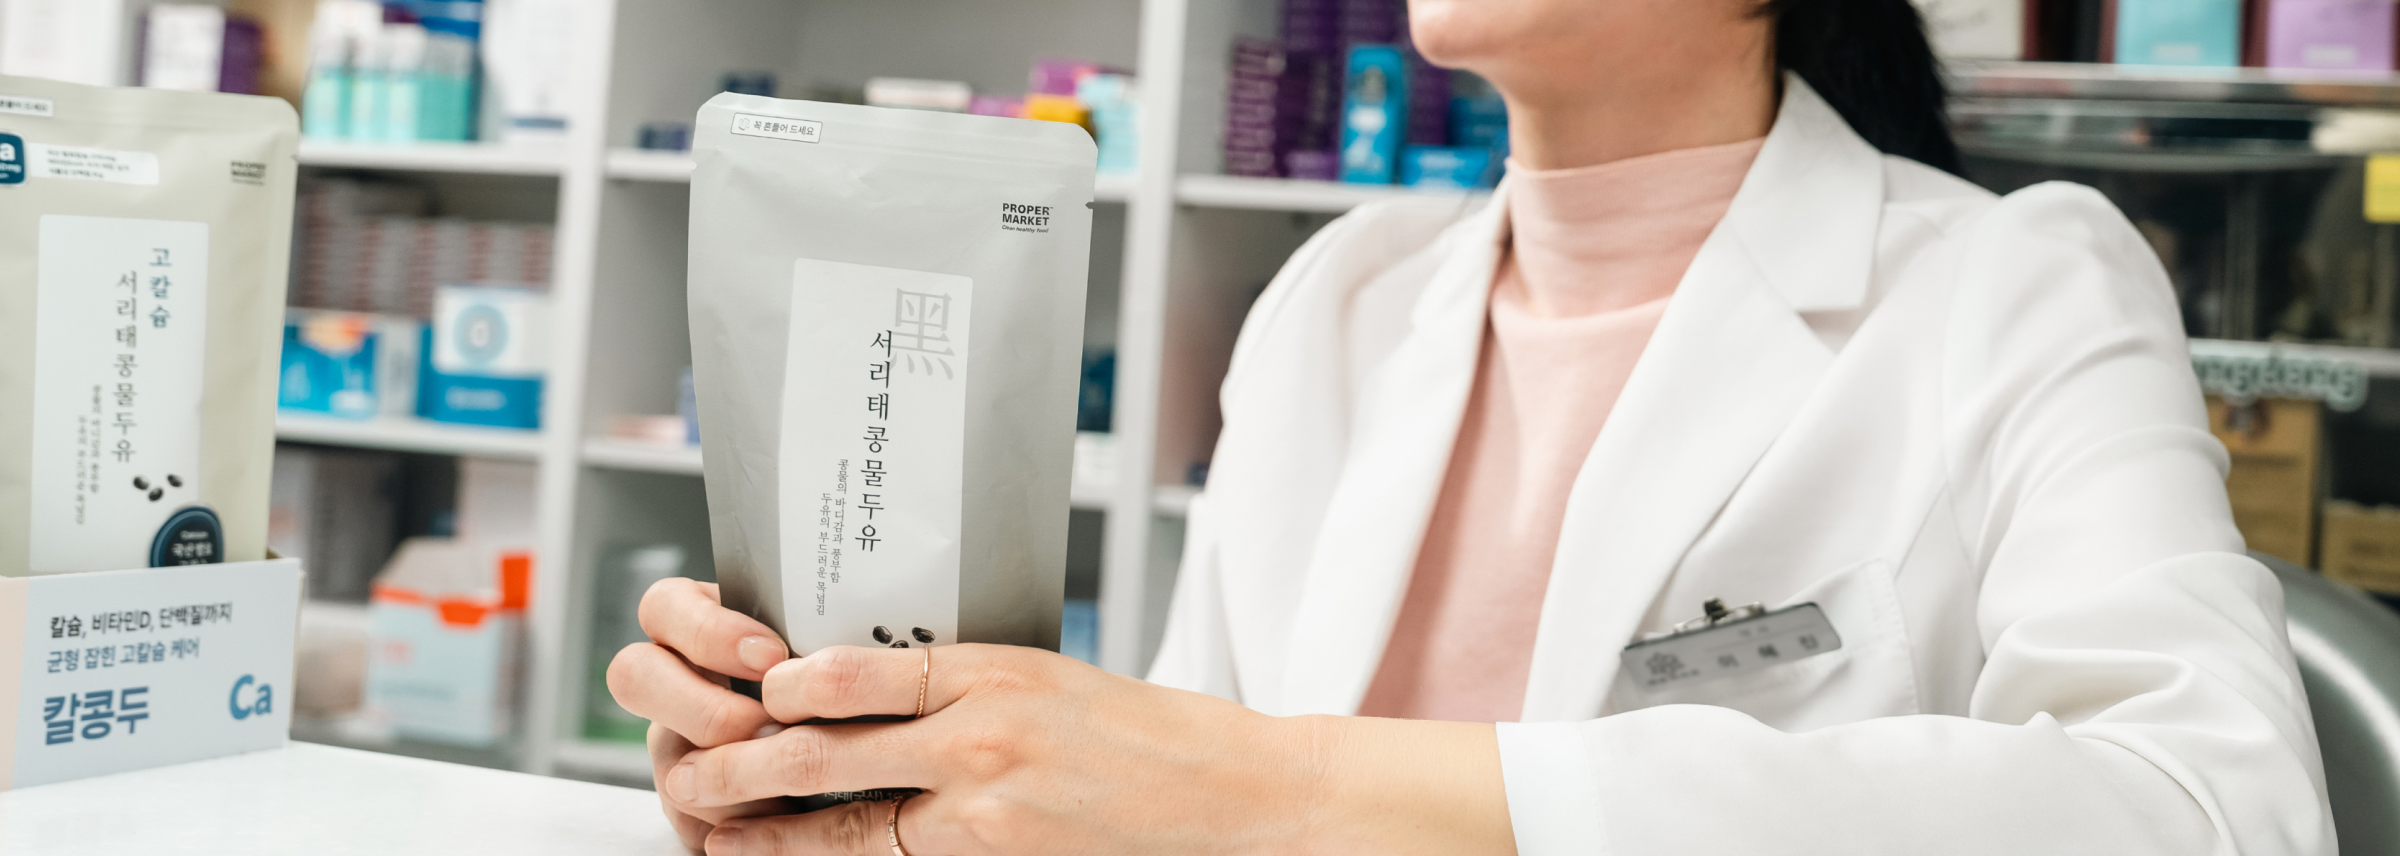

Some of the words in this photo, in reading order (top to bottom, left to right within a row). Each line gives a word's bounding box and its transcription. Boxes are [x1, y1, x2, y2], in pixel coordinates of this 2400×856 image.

[753, 120, 762, 131] 꼭
[763, 122, 788, 134] 흔들어
[789, 125, 814, 136] 드세요
[1002, 203, 1049, 215] PROPER
[1002, 213, 1050, 226] MARKET
[148, 248, 173, 329] 고칼슘
[884, 287, 956, 381] 黑
[111, 269, 138, 464] 서리태콩물두유
[855, 329, 893, 552] 서리태콩물두유
[837, 459, 850, 495] 콩물의
[820, 492, 832, 528] 두유의
[832, 498, 847, 545] 바디감과
[817, 532, 829, 578] 부드러운
[830, 548, 842, 584] 풍부함
[816, 581, 827, 616] 목넘김
[51, 613, 87, 639] 칼슘,
[92, 611, 155, 633] 비타민D,
[160, 603, 233, 628] 단백질까지
[47, 648, 79, 674] 균형
[84, 645, 116, 669] 잡힌
[120, 640, 167, 664] 고칼슘
[170, 637, 201, 660] 케어
[43, 686, 149, 745] 칼콩두
[229, 674, 273, 720] Ca
